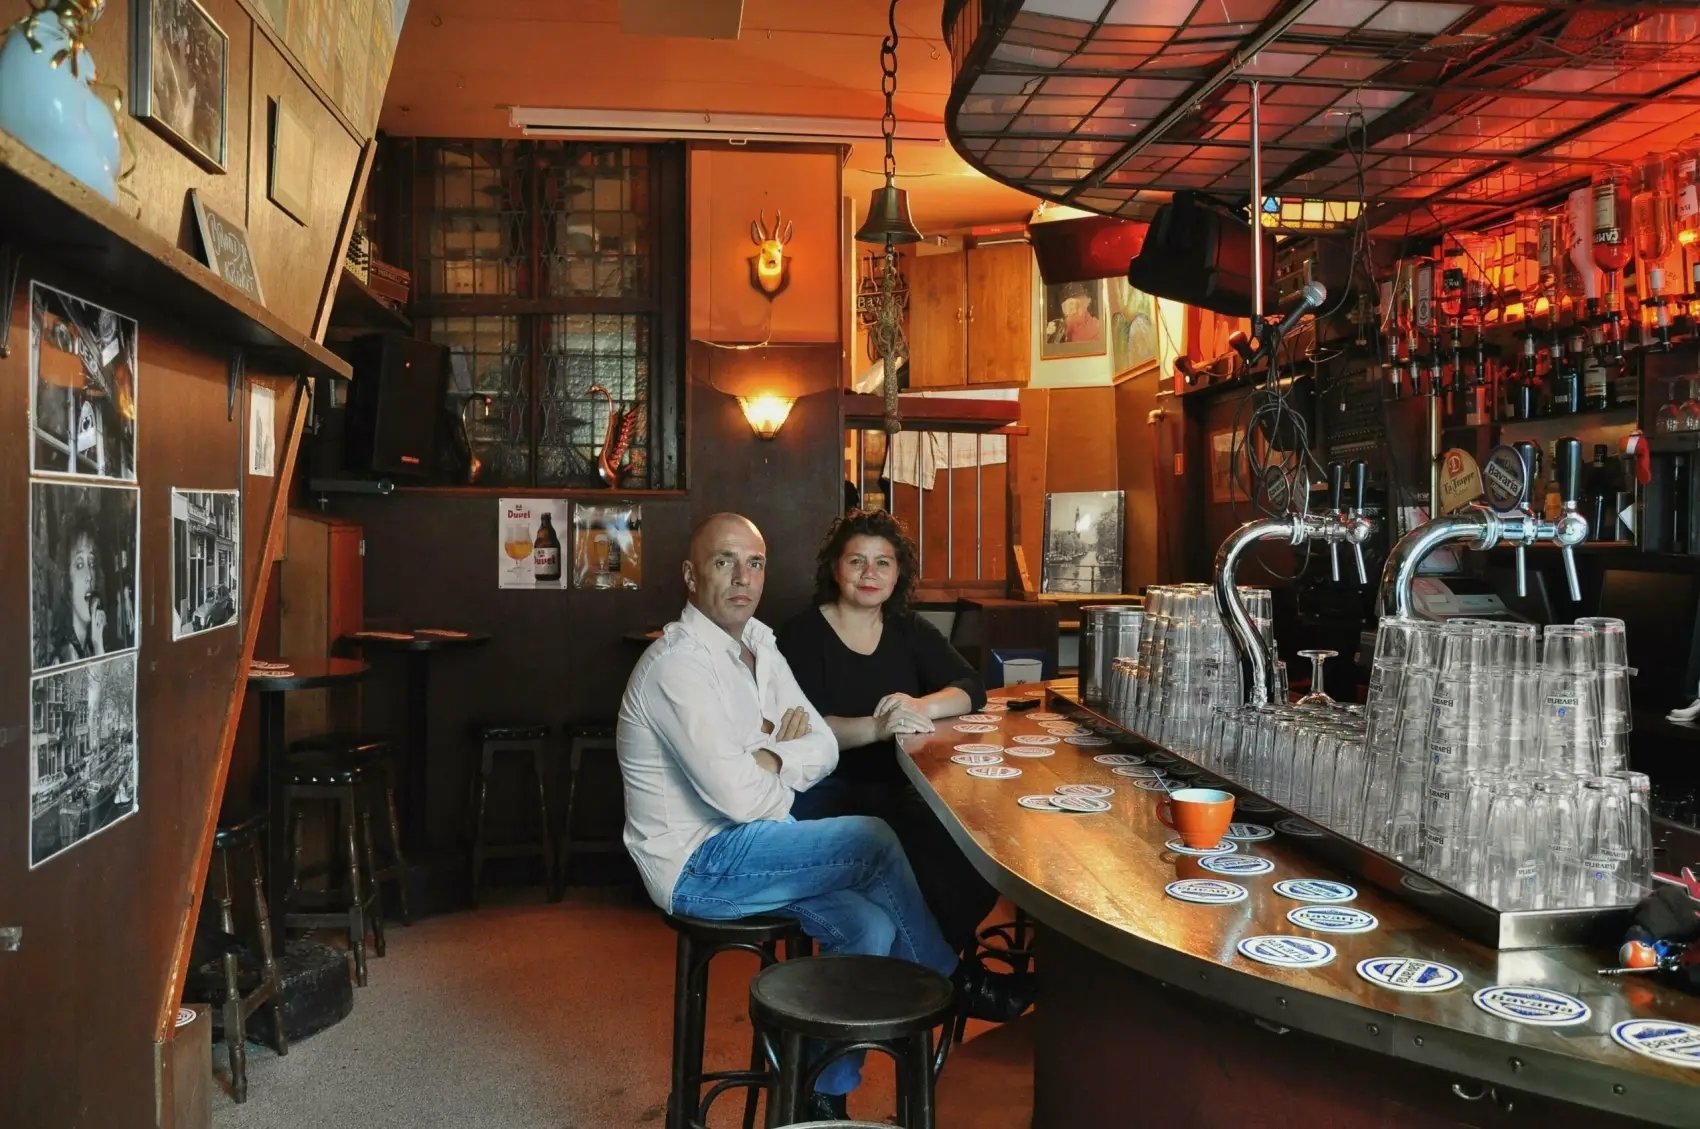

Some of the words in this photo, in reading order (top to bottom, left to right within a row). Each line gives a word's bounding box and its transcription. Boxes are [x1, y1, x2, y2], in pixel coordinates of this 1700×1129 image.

[1487, 464, 1519, 494] Bavaria
[507, 509, 531, 519] Duvel
[1300, 911, 1365, 923] Bavaria
[1395, 961, 1426, 984] Bavaria
[1491, 994, 1573, 1013] Bavaria
